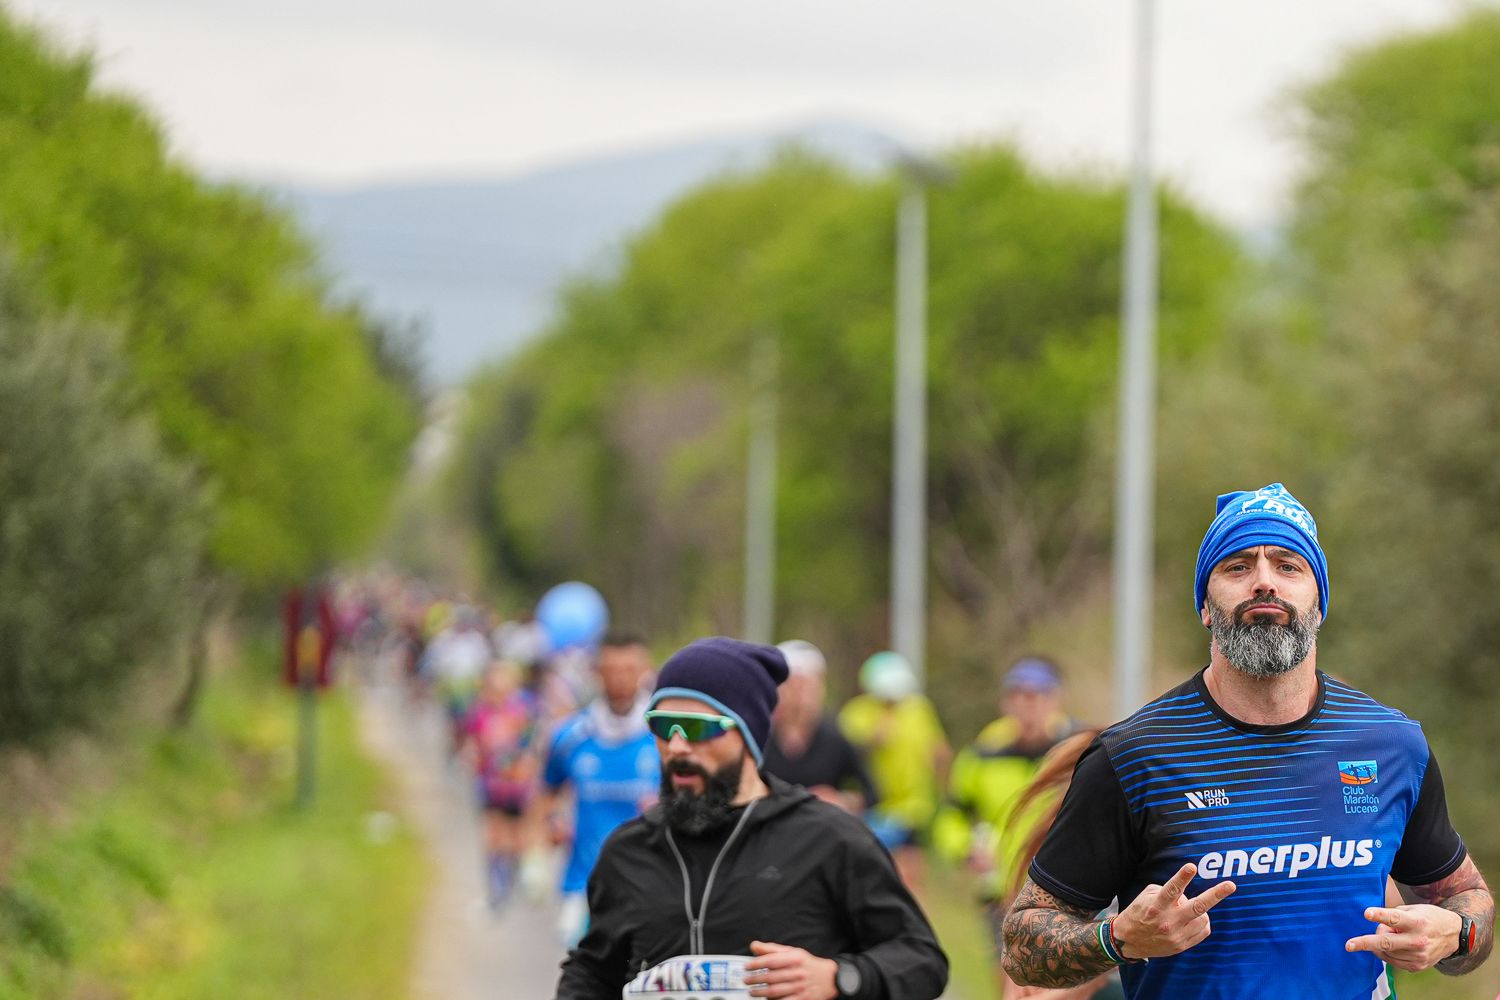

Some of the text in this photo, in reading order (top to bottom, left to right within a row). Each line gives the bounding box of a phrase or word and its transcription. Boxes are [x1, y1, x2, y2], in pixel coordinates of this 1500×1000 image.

[1203, 788, 1226, 799] RUN
[1342, 785, 1365, 796] Club
[1208, 796, 1230, 807] PRO
[1343, 794, 1380, 805] Maratón
[1344, 804, 1379, 814] Lucena
[1198, 835, 1374, 879] enerplus
